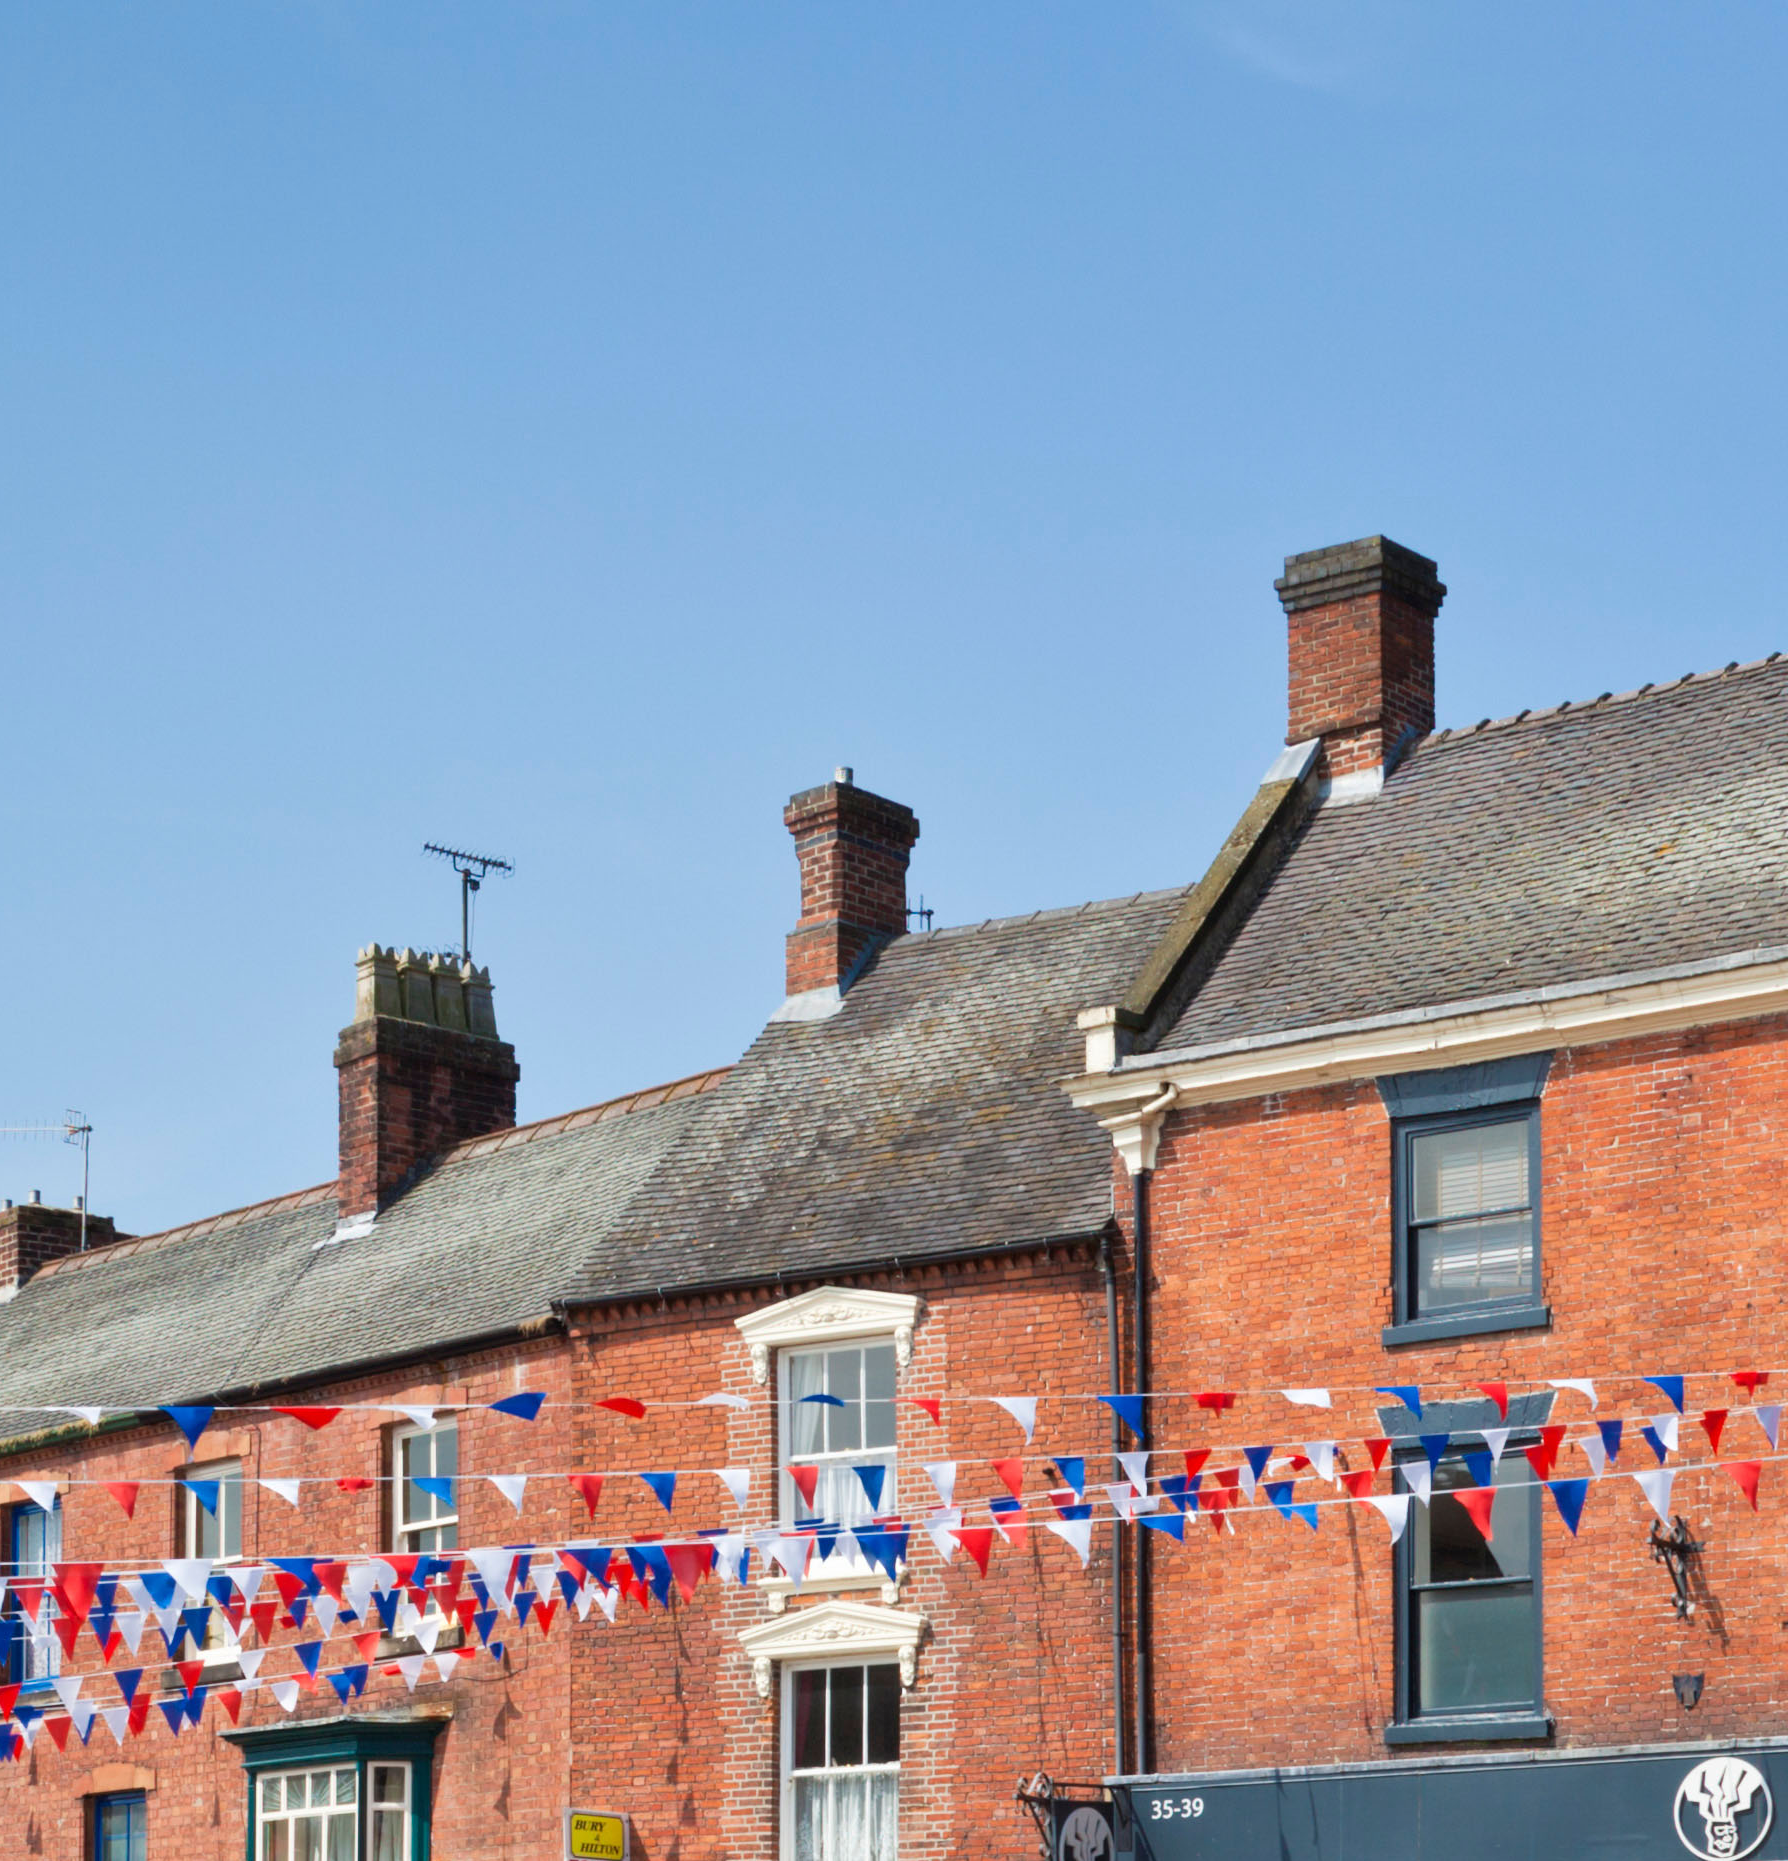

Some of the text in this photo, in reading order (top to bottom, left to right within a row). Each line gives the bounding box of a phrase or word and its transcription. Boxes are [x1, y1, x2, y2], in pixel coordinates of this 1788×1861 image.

[1151, 1797, 1204, 1819] 35-39
[574, 1819, 606, 1832] BURY
[580, 1843, 620, 1855] HILTON
